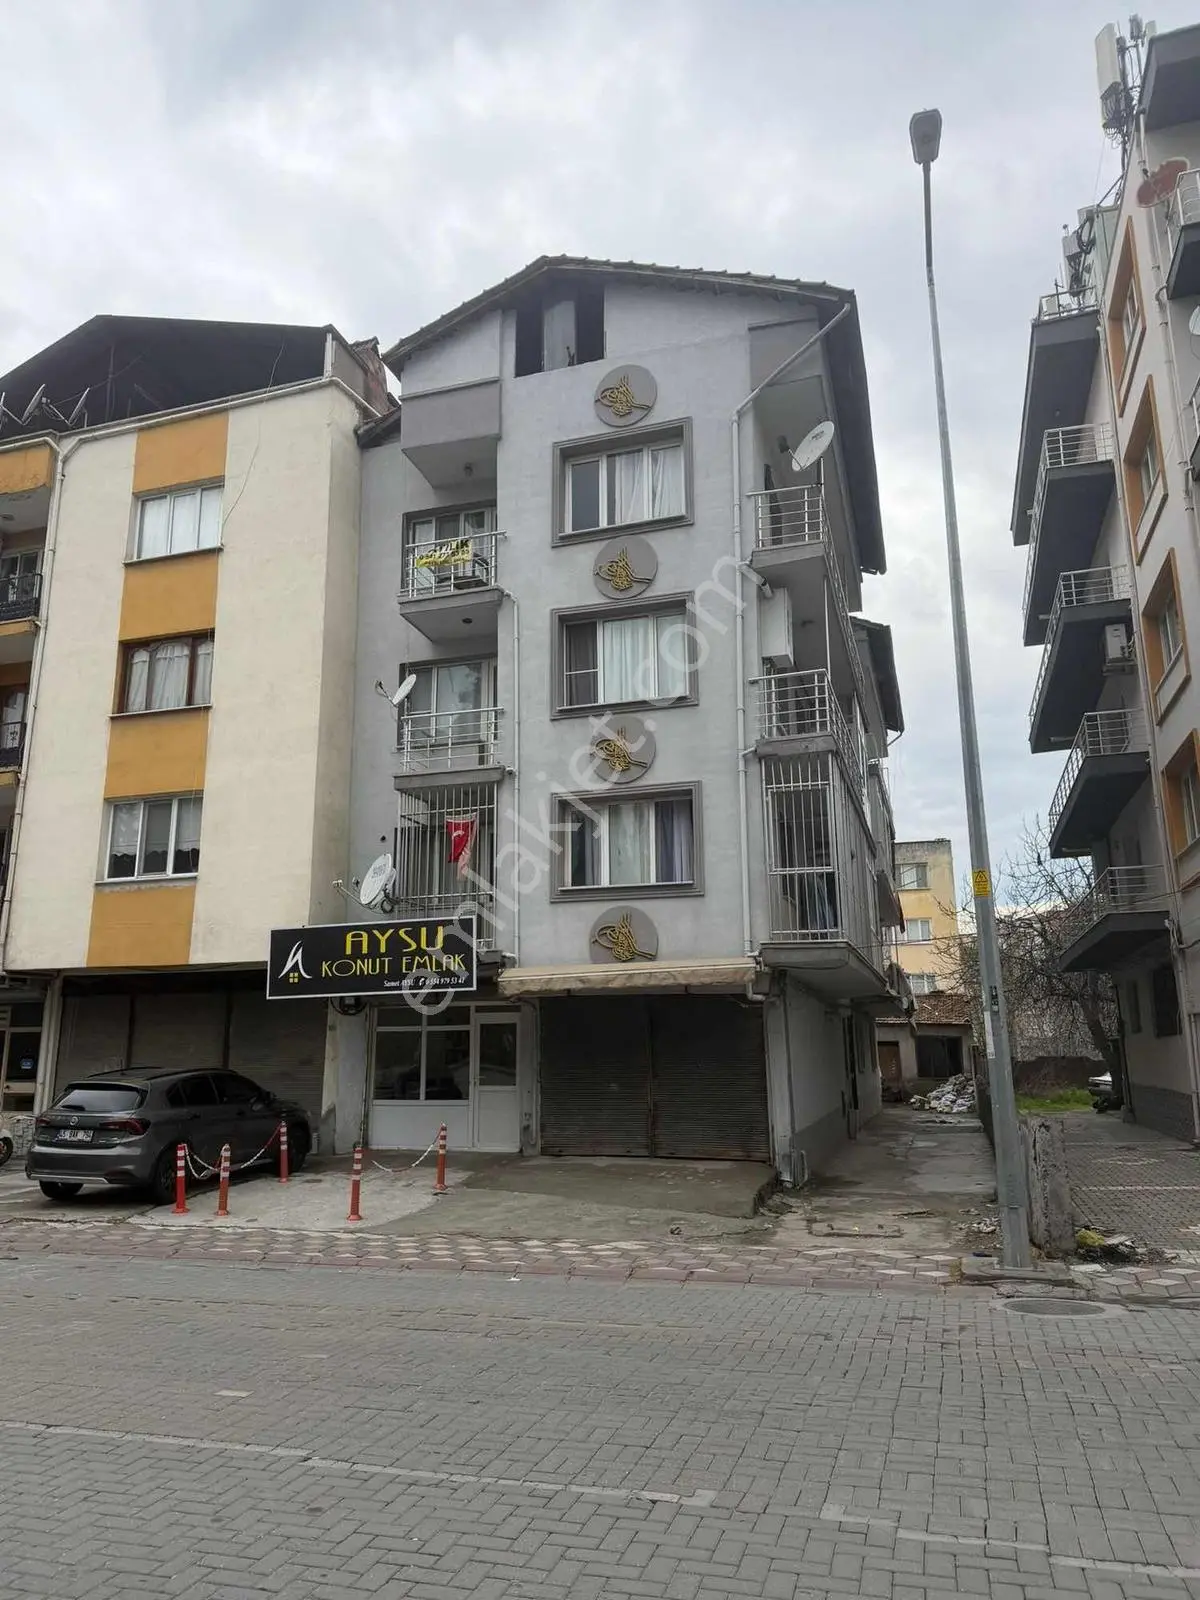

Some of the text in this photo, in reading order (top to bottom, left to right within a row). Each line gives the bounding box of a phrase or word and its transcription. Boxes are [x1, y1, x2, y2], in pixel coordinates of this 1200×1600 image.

[346, 927, 444, 955] AYSU
[322, 953, 466, 977] KONUT EMLAK
